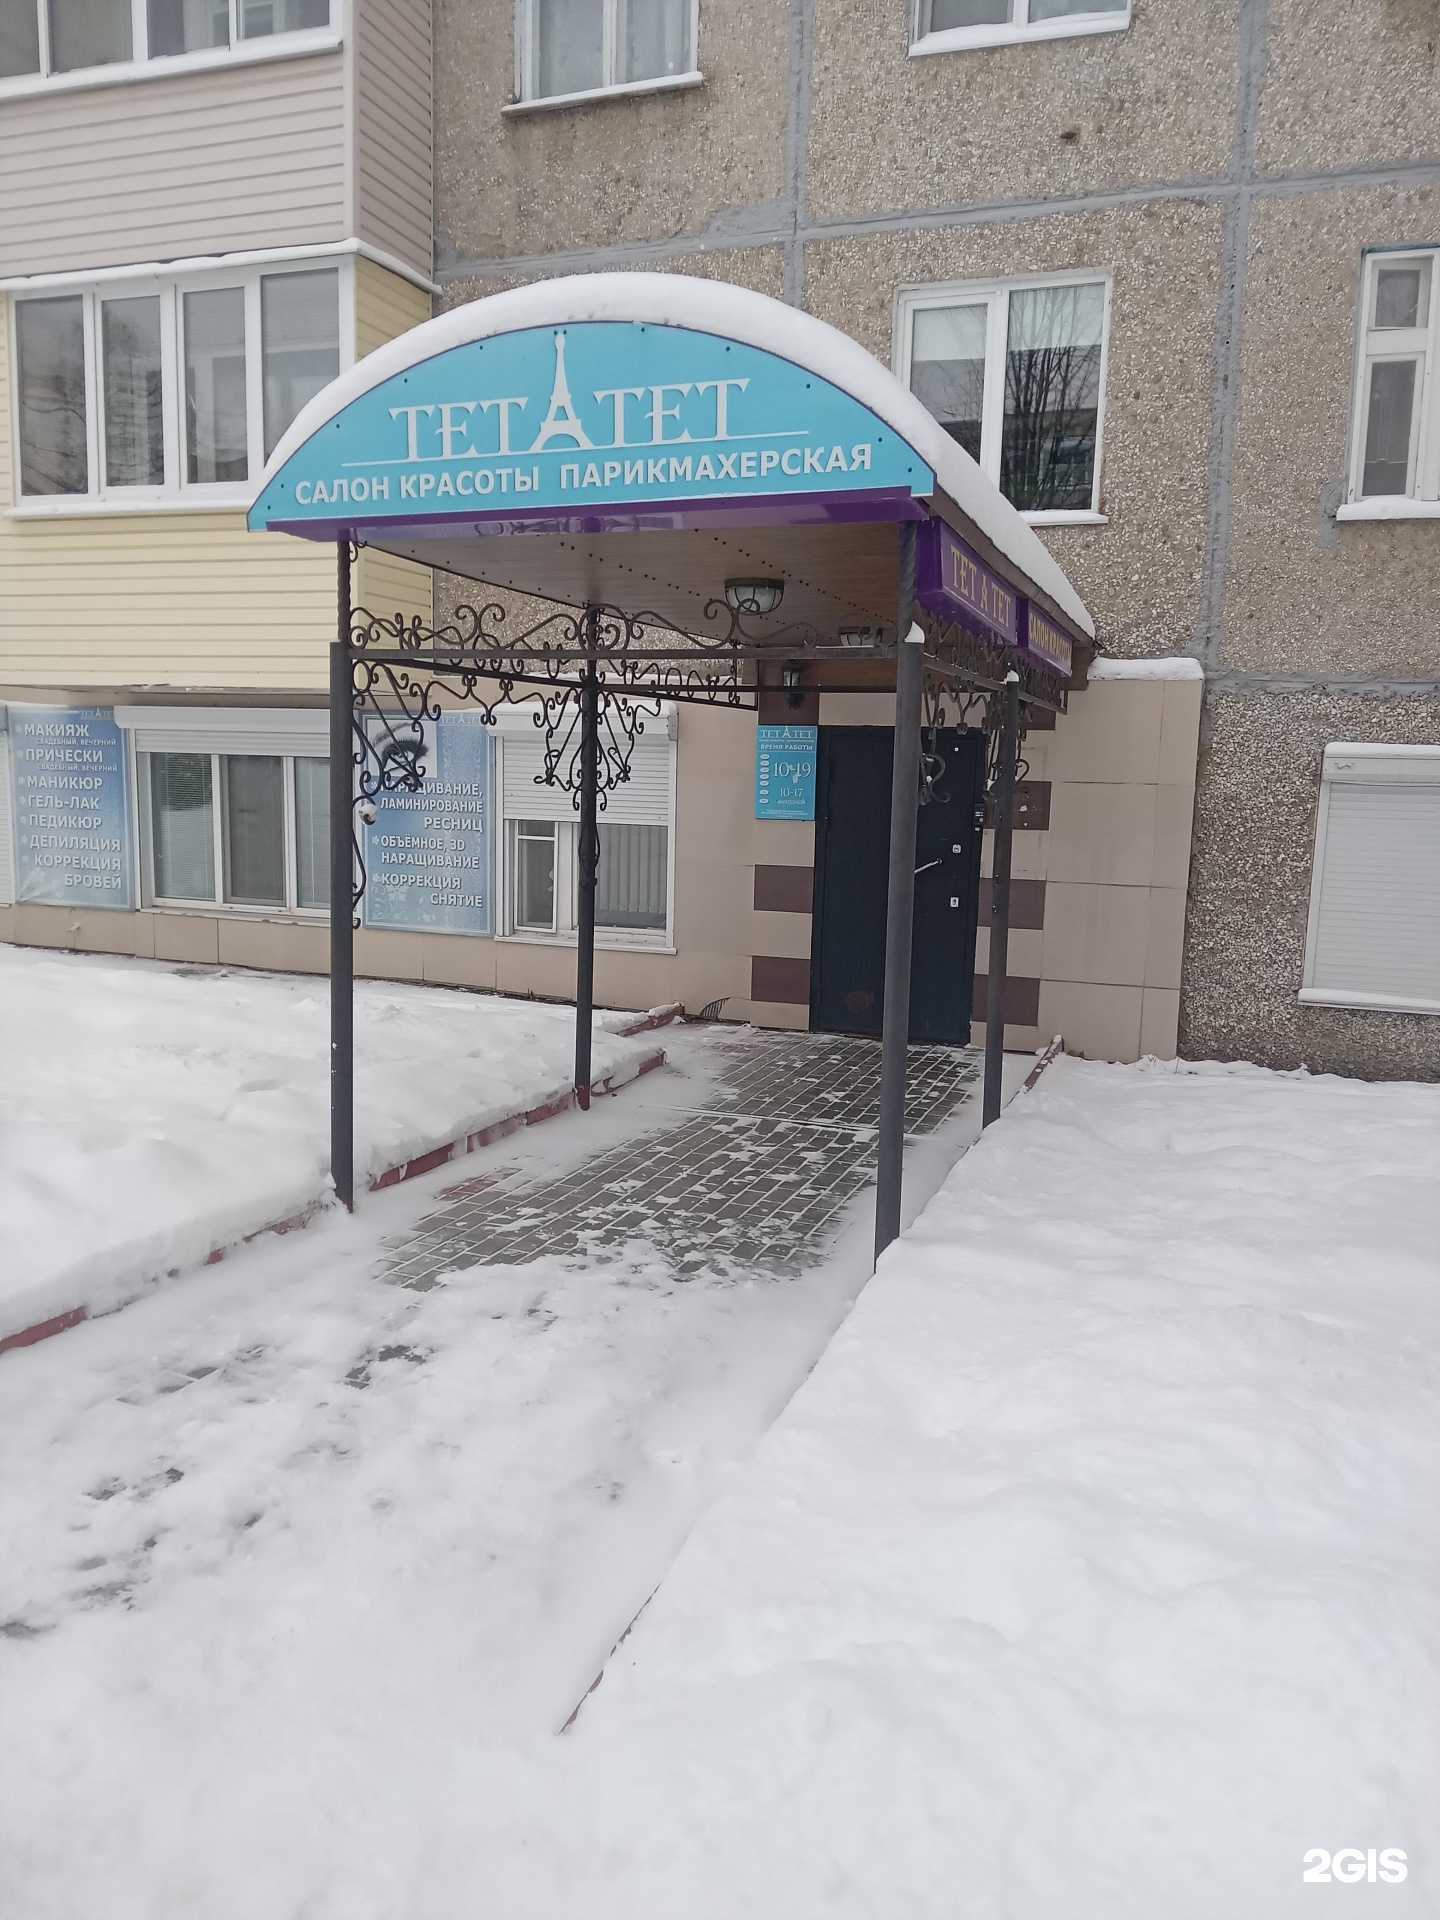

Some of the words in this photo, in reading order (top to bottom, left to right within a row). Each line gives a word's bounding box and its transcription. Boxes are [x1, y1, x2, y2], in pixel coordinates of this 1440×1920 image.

[295, 480, 391, 505] САЛОН
[399, 466, 540, 500] КРАСОТЫ
[559, 442, 873, 488] ПАРИКМАХЕРСКАЯ
[951, 545, 977, 601] ТЕТ
[991, 582, 1011, 627] ТЕТ
[24, 723, 90, 737] МАКИЯЖ
[25, 749, 104, 763] ПРИЧЕСКИ
[26, 775, 103, 790] МАНИКЮР
[380, 780, 483, 798] РЩИВАНИЕ,
[28, 795, 100, 810] ГЕЛЬ-ЛАК
[380, 797, 483, 813] ЛАМИНИРОВАНИЕ
[28, 814, 103, 830] ПЕДИКЮР
[424, 816, 483, 832] РЕСНИЦ
[30, 834, 121, 852] ДЕПИЛЯЦИЯ
[450, 839, 466, 851] 3D
[34, 854, 121, 872] КОРРЕКЦИЯ
[381, 852, 480, 869] НАРАЩИВАНИЕ
[64, 872, 122, 889] БРОВЕЙ
[382, 873, 462, 889] КОРРЕКЦИЯ
[430, 893, 483, 907] СНЯТИЕ
